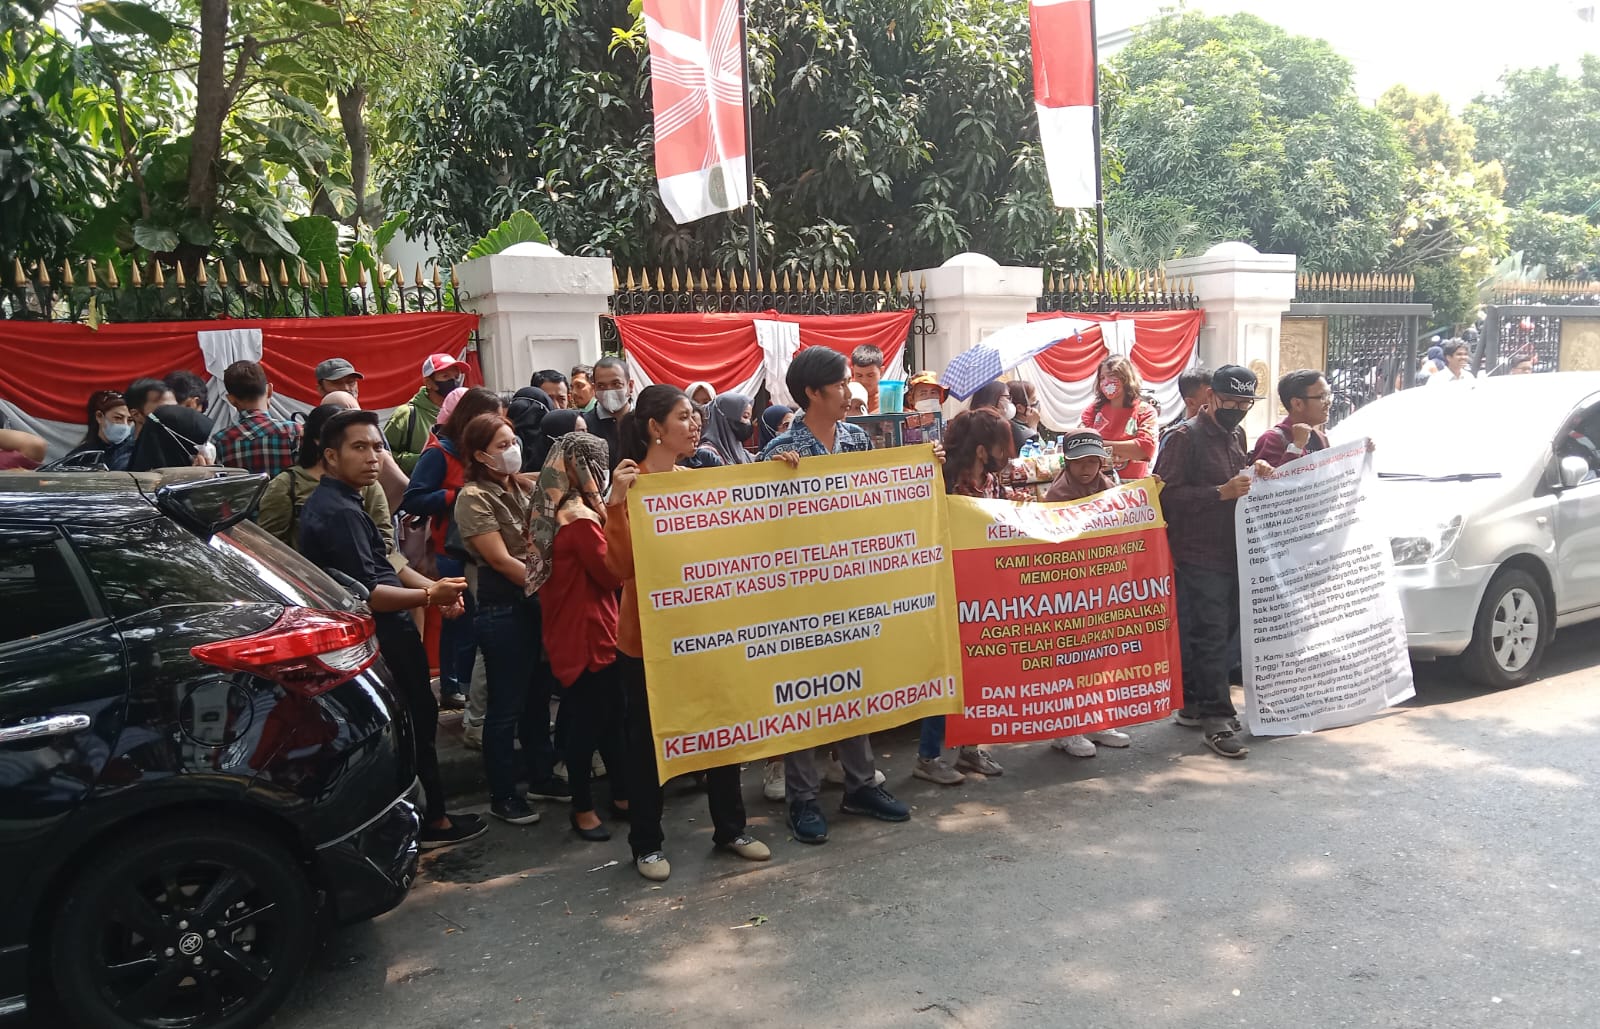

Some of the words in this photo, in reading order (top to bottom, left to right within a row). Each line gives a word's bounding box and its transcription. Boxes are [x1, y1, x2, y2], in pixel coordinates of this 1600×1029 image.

[645, 490, 727, 513] TANGKAP
[732, 479, 821, 502] RUDIYANTO
[825, 476, 848, 491] PEI
[851, 470, 888, 487] YANG
[890, 465, 934, 481] TELAH
[656, 505, 765, 533] DIBEBASKAN
[769, 504, 783, 518] DI
[787, 491, 883, 516] PENGADILAN
[884, 484, 930, 502] TINGGI
[988, 522, 1032, 539] KEPA
[1046, 515, 1120, 536] AHAMAH
[1122, 508, 1155, 527] AGUNG
[683, 556, 771, 581] RUDIYANTO
[775, 553, 798, 567] PEI
[801, 544, 848, 563] TELAH
[851, 532, 916, 554] TERBUKTI
[995, 556, 1030, 569] KAMI
[1034, 550, 1085, 565] KORBAN
[1088, 545, 1119, 558] INDRA
[1121, 540, 1145, 552] KENZ
[1248, 545, 1269, 555] deng
[651, 583, 733, 609] TERJERAT
[737, 574, 786, 593] KASUS
[790, 567, 830, 585] TPPU
[833, 563, 865, 579] DARI
[869, 556, 909, 573] INDRA
[912, 548, 943, 564] KENZ
[1020, 568, 1086, 585] MEMOHON
[1089, 561, 1128, 575] KEPADA
[1251, 584, 1282, 594] memoh
[959, 587, 1102, 622] MAHKAMAH
[981, 624, 1021, 640] AGAR
[1024, 621, 1051, 635] HAK
[1054, 618, 1085, 631] KAMI
[1088, 602, 1166, 627] DIKEMBALIKAN
[1252, 606, 1267, 614] hak
[673, 635, 734, 654] KENAPA
[738, 616, 819, 640] RUDIYANTO
[823, 613, 845, 627] PEI
[848, 605, 891, 621] KEBAL
[893, 595, 936, 613] HUKUM
[966, 642, 1007, 657] YANG
[1010, 640, 1053, 655] TELAH
[1056, 628, 1114, 649] GELAPKAN
[1117, 624, 1142, 638] DAN
[747, 644, 777, 659] DAN
[780, 626, 871, 652] DIBEBASKAN
[1022, 657, 1053, 671] DARI
[1056, 643, 1118, 665] RUDIYANTO
[1122, 640, 1141, 652] PEI
[982, 686, 1015, 700] DAN
[1020, 678, 1074, 697] KENAPA
[1076, 665, 1152, 689] RUDIYANTO
[1154, 660, 1169, 674] PEI
[1255, 664, 1278, 672] Tinggi
[775, 670, 862, 703] MOHON
[665, 712, 811, 758] KEMBALIKAN
[817, 701, 861, 724] HAK
[867, 680, 942, 714] KORBAN
[964, 704, 1018, 719] KEBAL
[1022, 697, 1074, 716] HUKUM
[1076, 692, 1103, 707] DAN
[991, 723, 1007, 736] DI
[1012, 709, 1103, 734] PENGADILAN
[1106, 704, 1152, 722] TINGGI
[1154, 697, 1170, 713] ???
